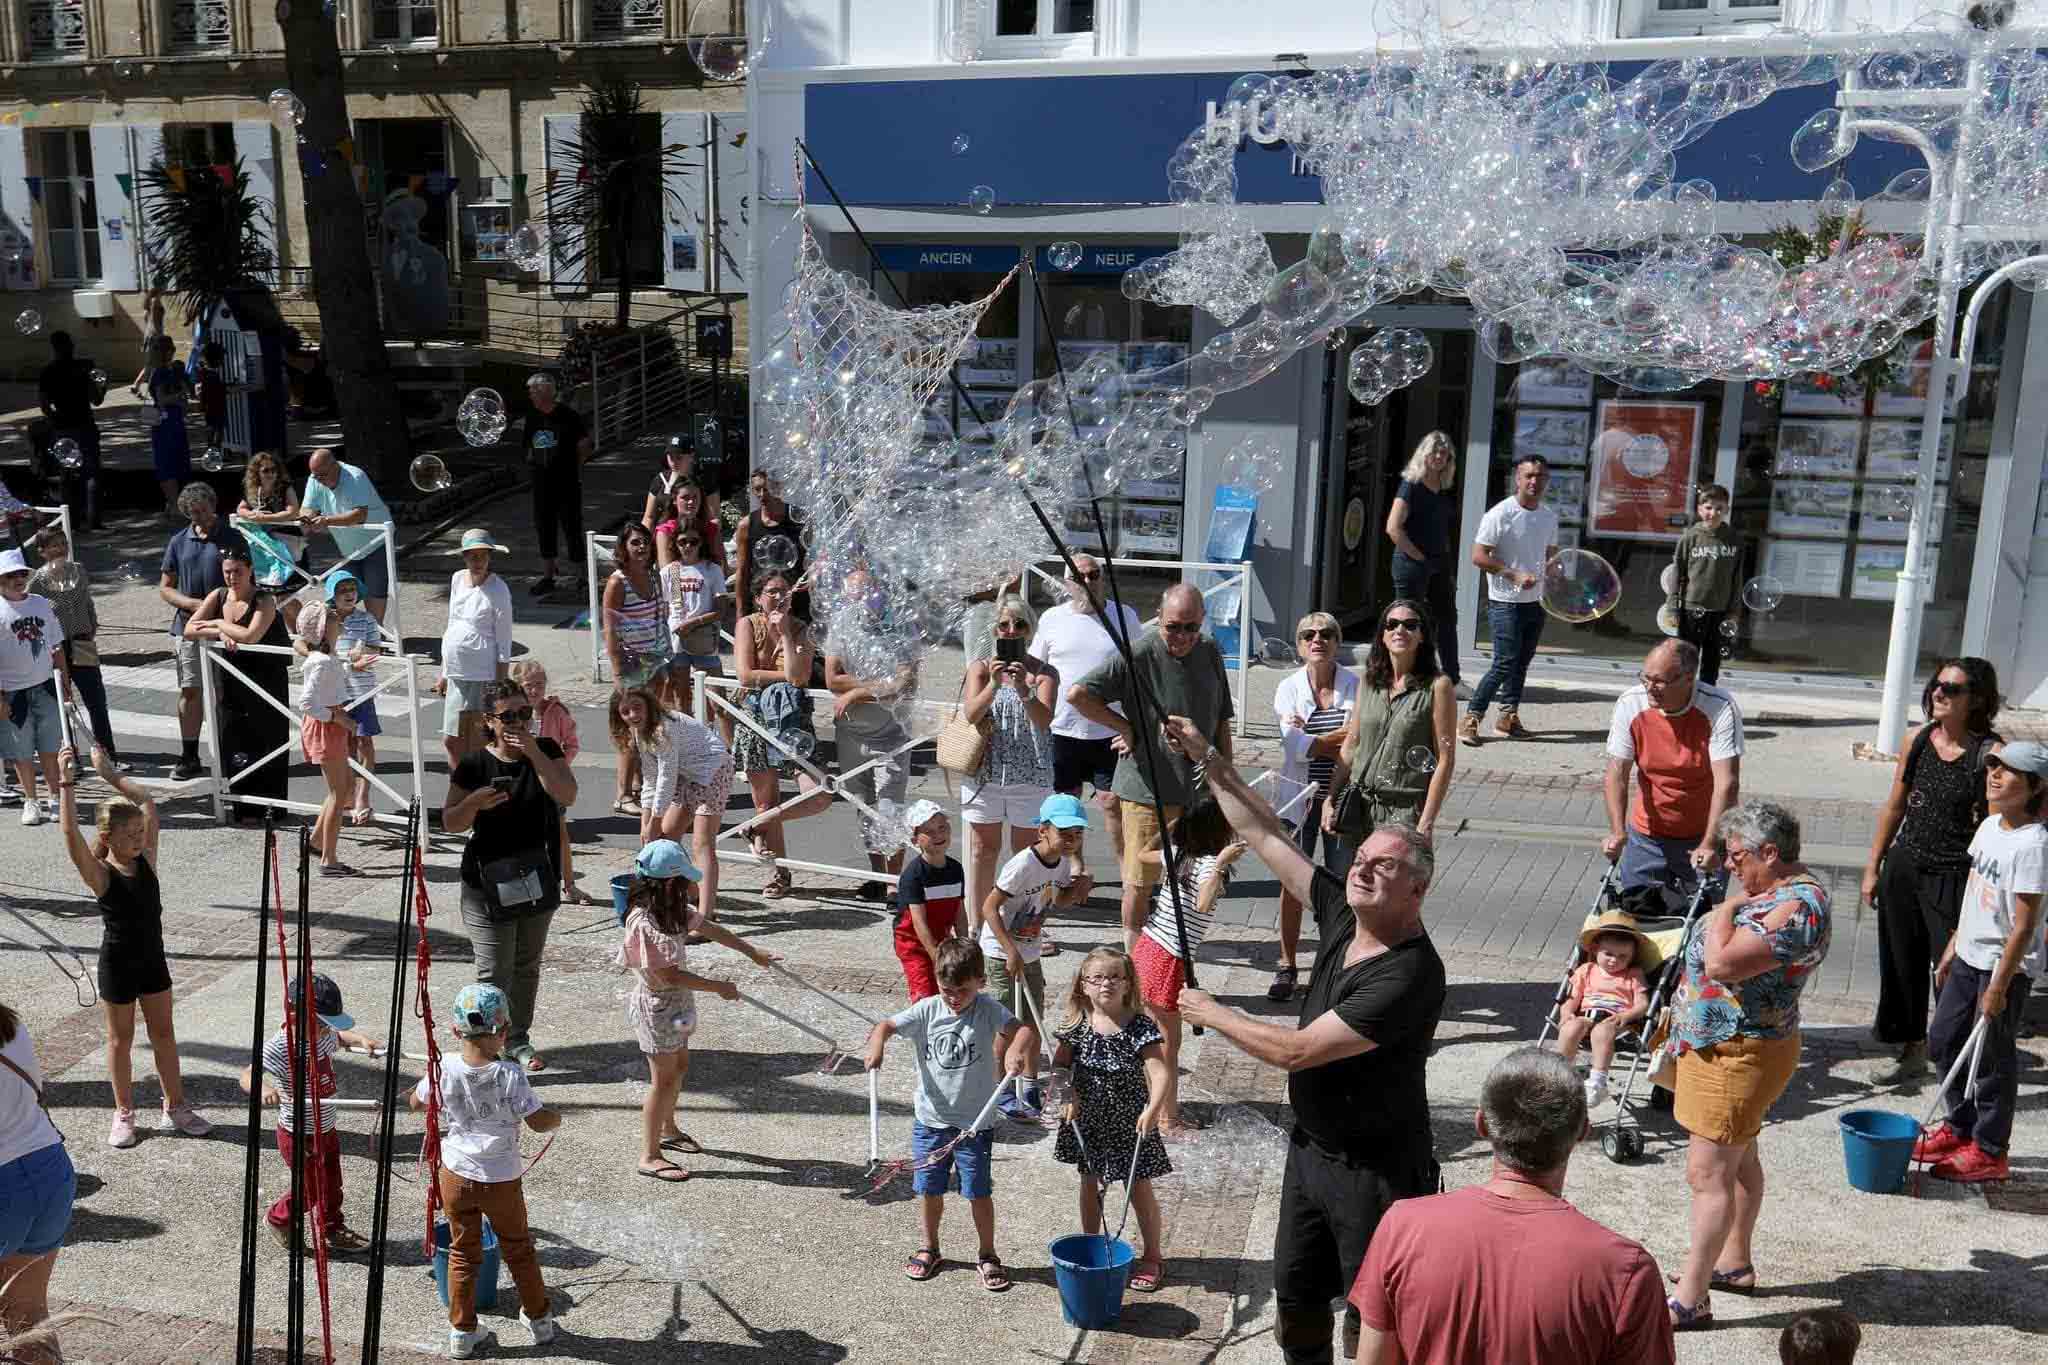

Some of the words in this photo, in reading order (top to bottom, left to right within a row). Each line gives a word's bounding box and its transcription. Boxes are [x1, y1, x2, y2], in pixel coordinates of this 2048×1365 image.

[919, 252, 973, 265] ANCIEN
[1095, 253, 1136, 266] NEUF
[924, 1035, 977, 1062] SURF
